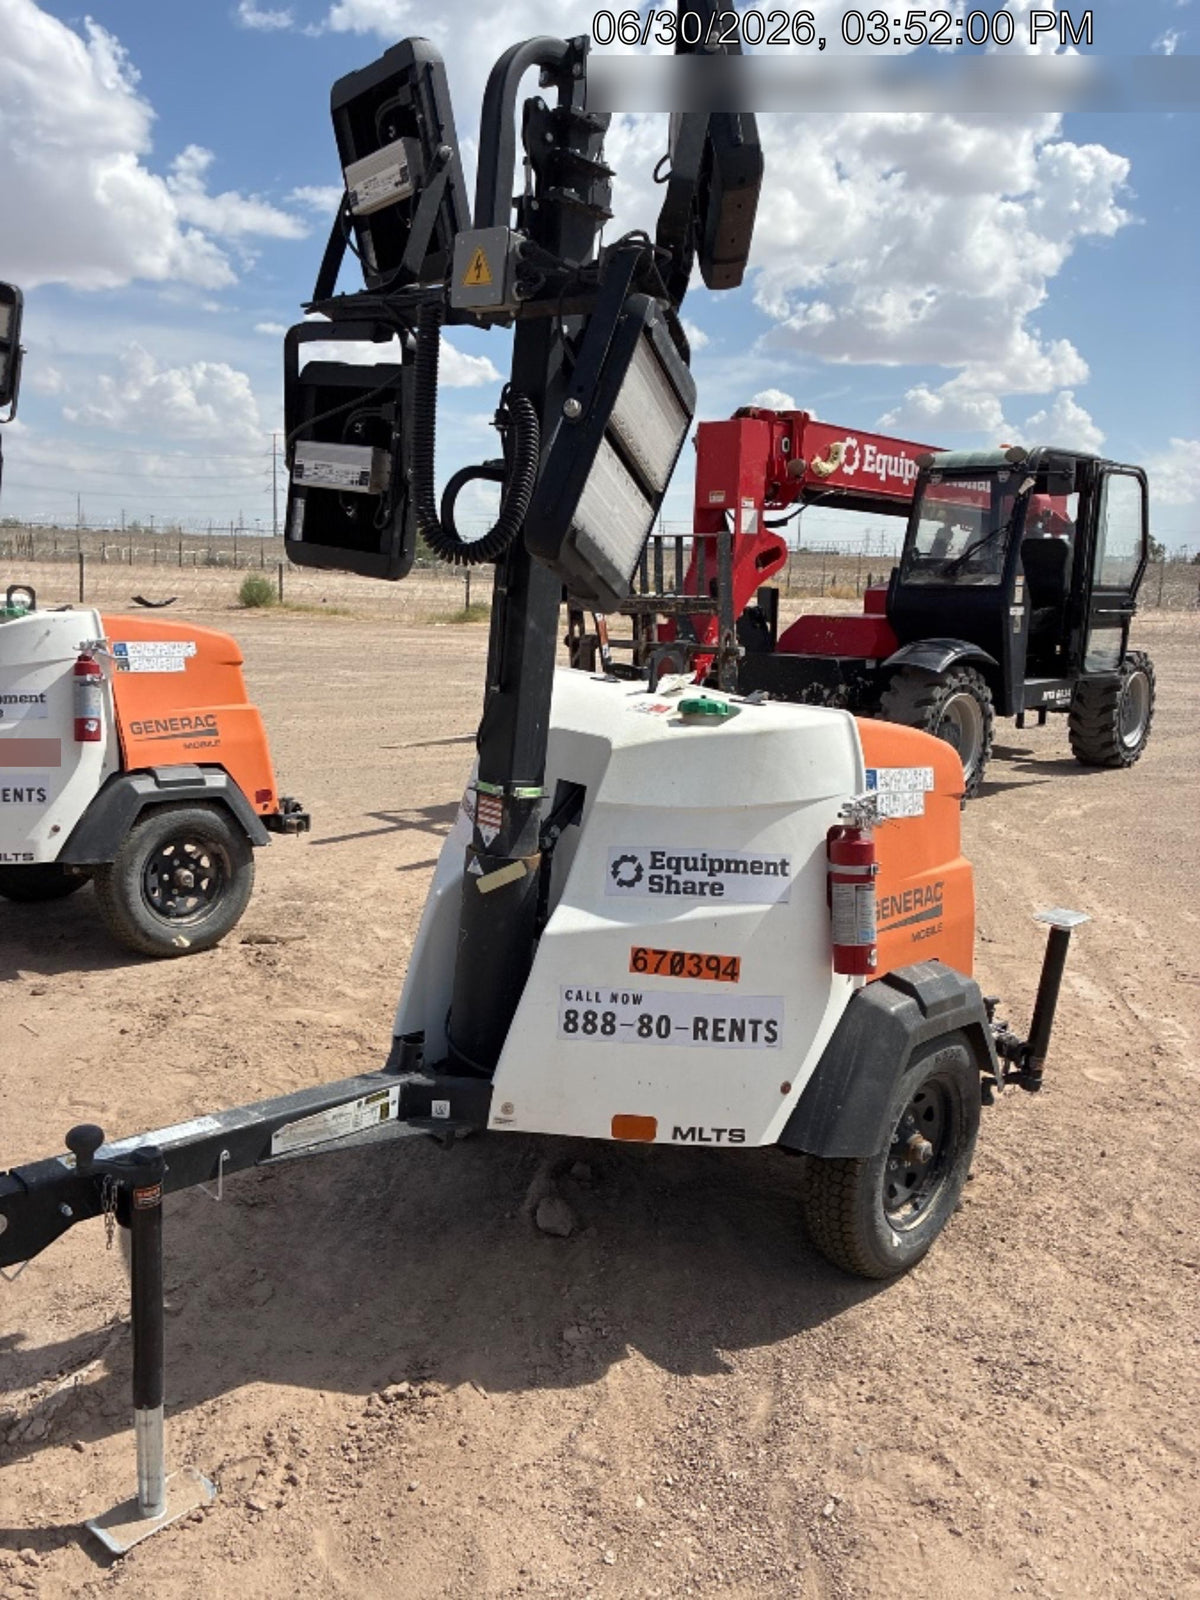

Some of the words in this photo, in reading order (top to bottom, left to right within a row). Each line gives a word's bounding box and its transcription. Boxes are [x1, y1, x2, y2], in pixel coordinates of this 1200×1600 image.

[0, 693, 47, 704] ment
[130, 714, 217, 735] GENERAC
[0, 852, 34, 862] LTS
[649, 851, 790, 877] Equipment
[648, 874, 725, 897] Share
[912, 922, 943, 942] MOBILE
[632, 947, 739, 981] 670394
[565, 989, 602, 1004] CALL
[610, 993, 643, 1006] NOW
[563, 1009, 779, 1044] 888-80-RENTS
[672, 1126, 746, 1143] MLTS
